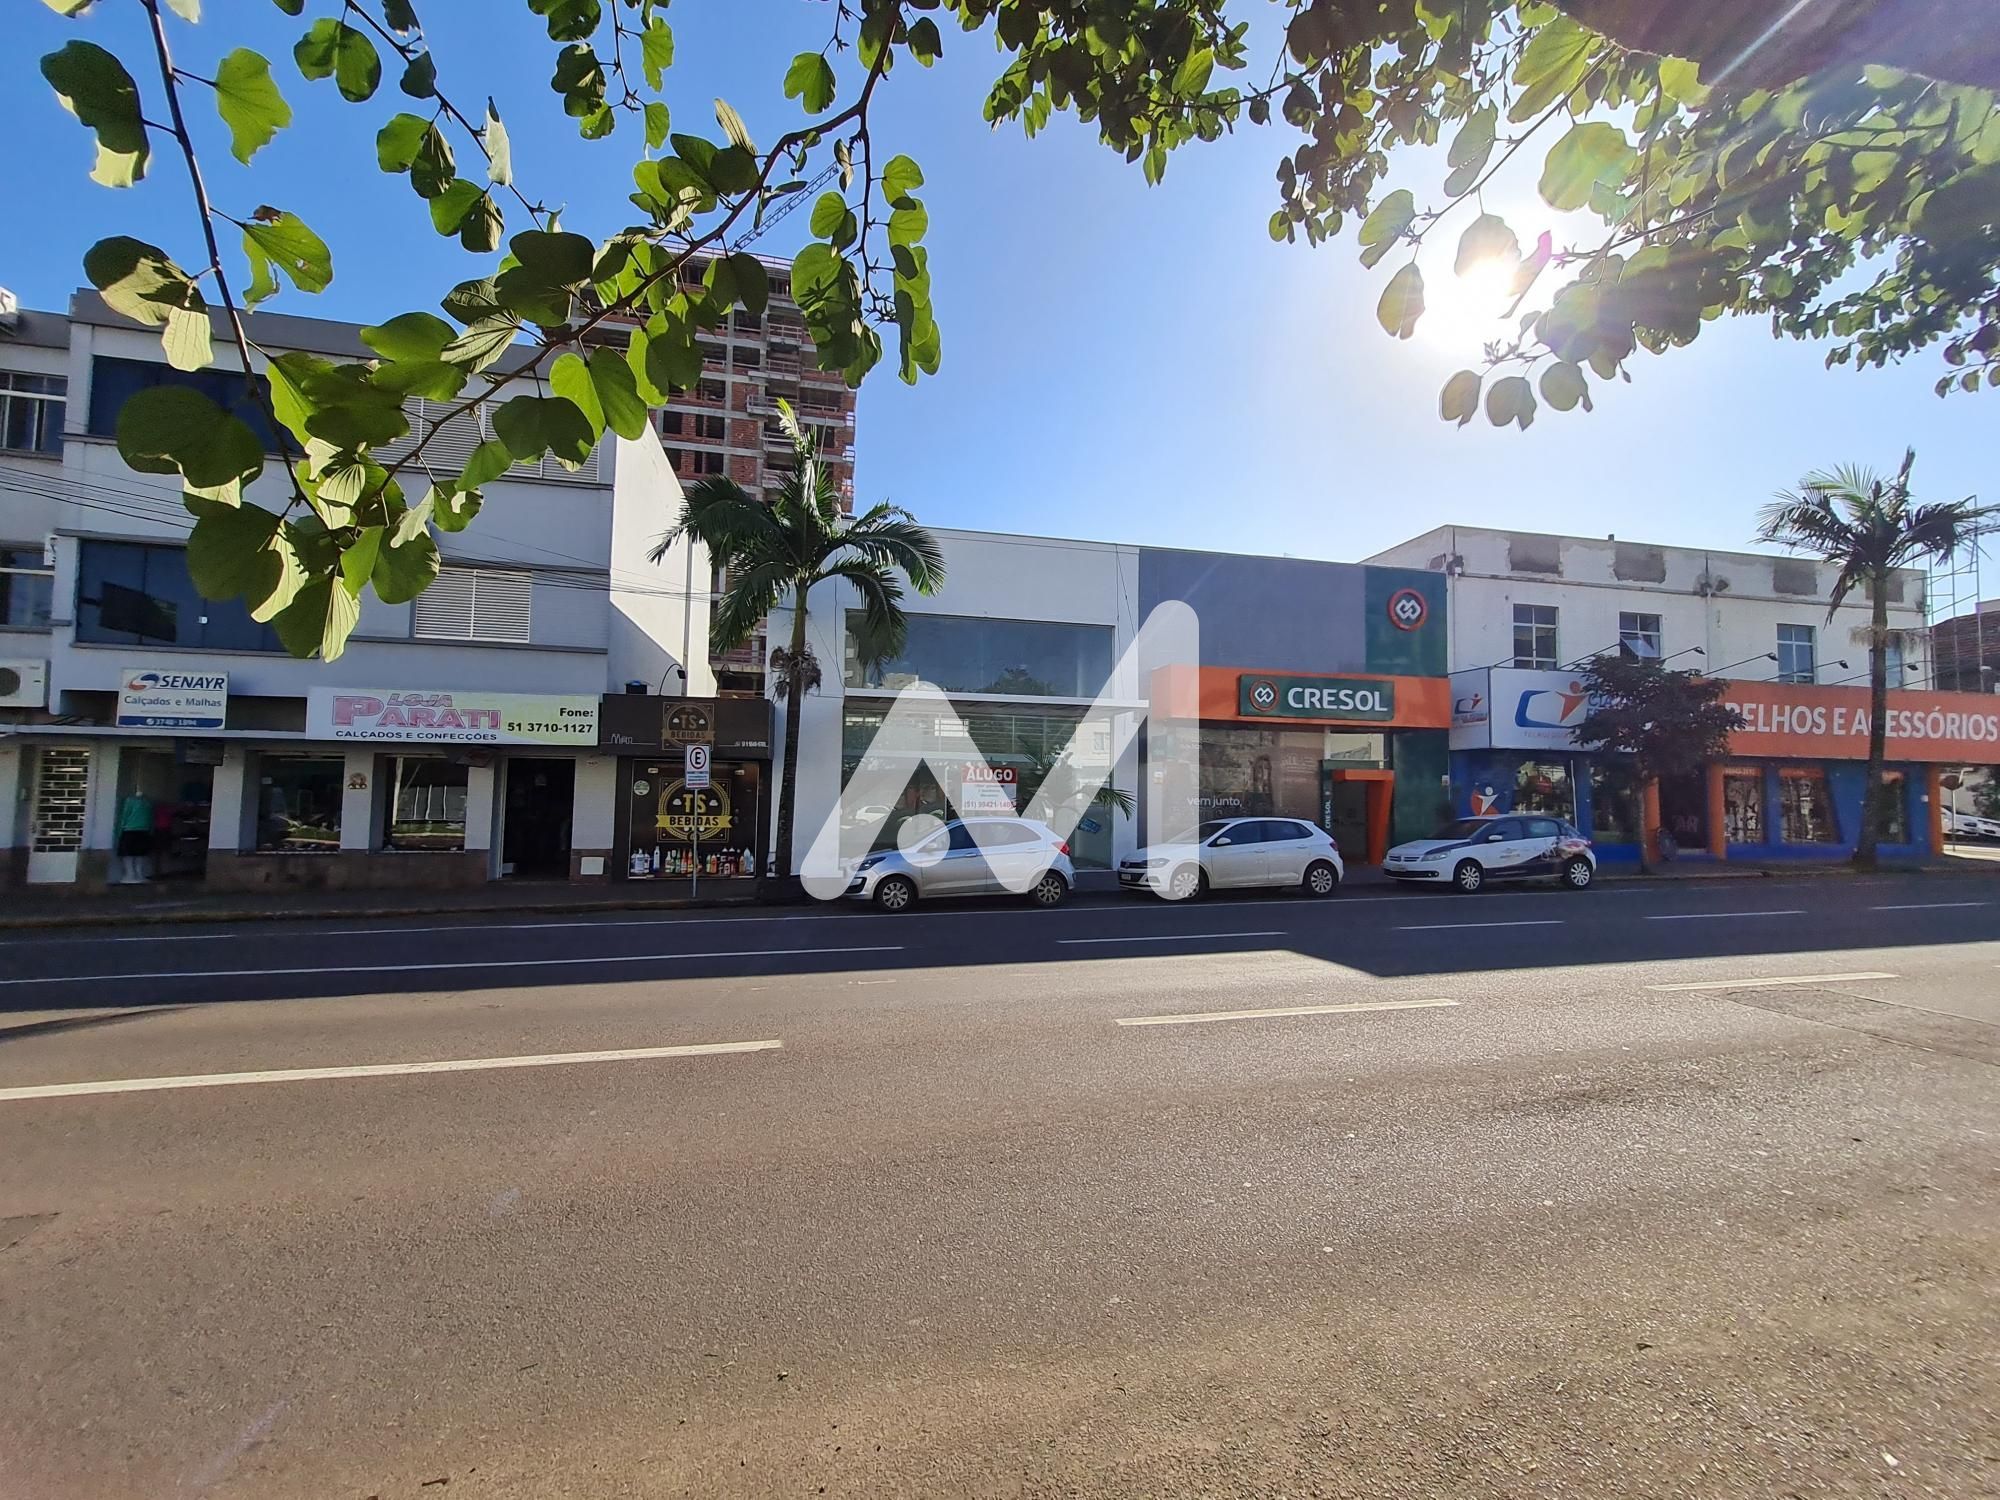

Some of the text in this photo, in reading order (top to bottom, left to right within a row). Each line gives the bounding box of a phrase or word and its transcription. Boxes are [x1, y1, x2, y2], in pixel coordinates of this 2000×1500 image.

[160, 675, 225, 689] SENAYR
[124, 695, 171, 706] Calçados
[185, 698, 222, 707] Malhas
[386, 693, 453, 707] LOJA
[1287, 687, 1389, 711] CRESOL
[332, 695, 501, 729] PARATI
[560, 707, 594, 717] Fone:
[507, 722, 593, 733] 51 3710-1127
[680, 714, 697, 729] TS
[1833, 707, 1847, 735] E
[1850, 706, 1998, 742] AESSÓRIOS
[335, 730, 402, 740] CALÇADOS
[417, 731, 497, 741] CONFECÇÕES
[694, 751, 702, 765] E
[966, 768, 1013, 781] ALUGO
[682, 793, 707, 813] TS
[1187, 797, 1211, 806] vem
[669, 816, 719, 826] BEBIDAS
